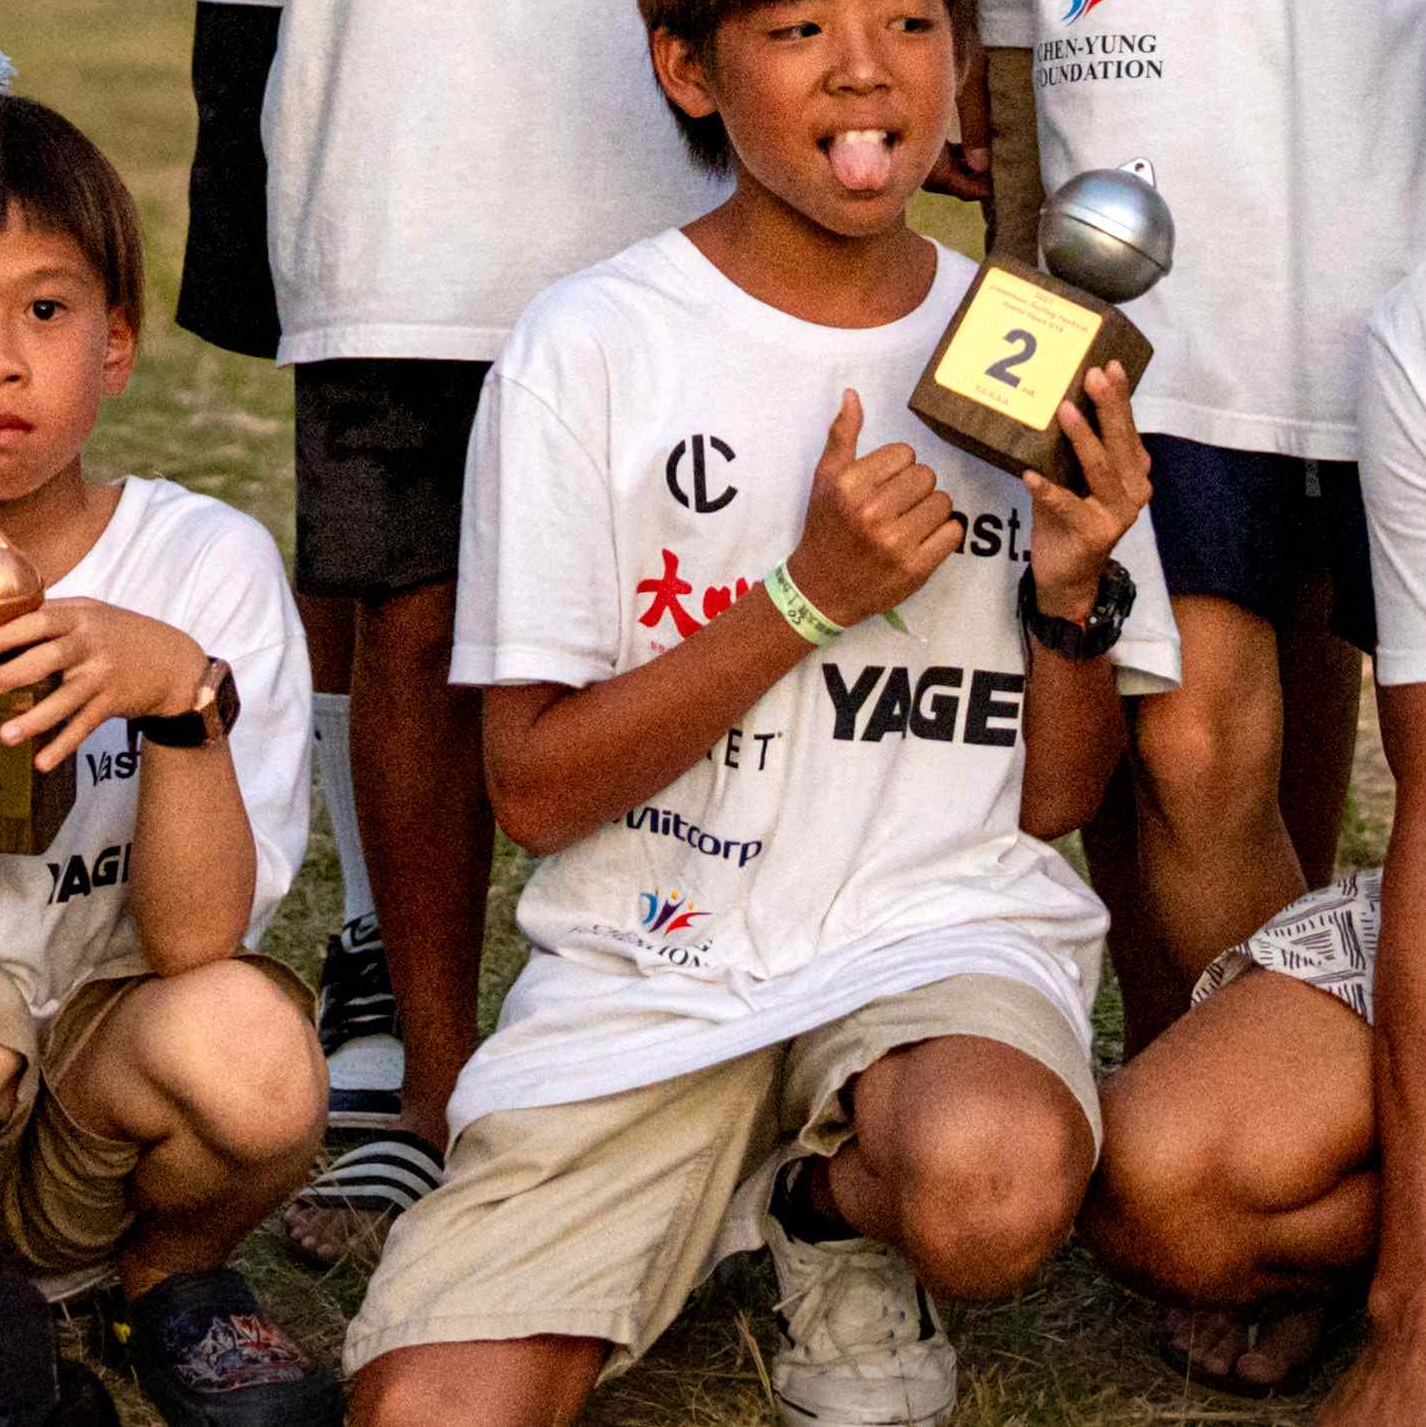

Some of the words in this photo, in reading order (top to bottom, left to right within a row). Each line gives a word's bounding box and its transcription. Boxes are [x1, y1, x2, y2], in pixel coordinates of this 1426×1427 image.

[1037, 60, 1164, 88] OUNDATION
[984, 328, 1038, 388] 2
[822, 664, 1026, 747] YAGE
